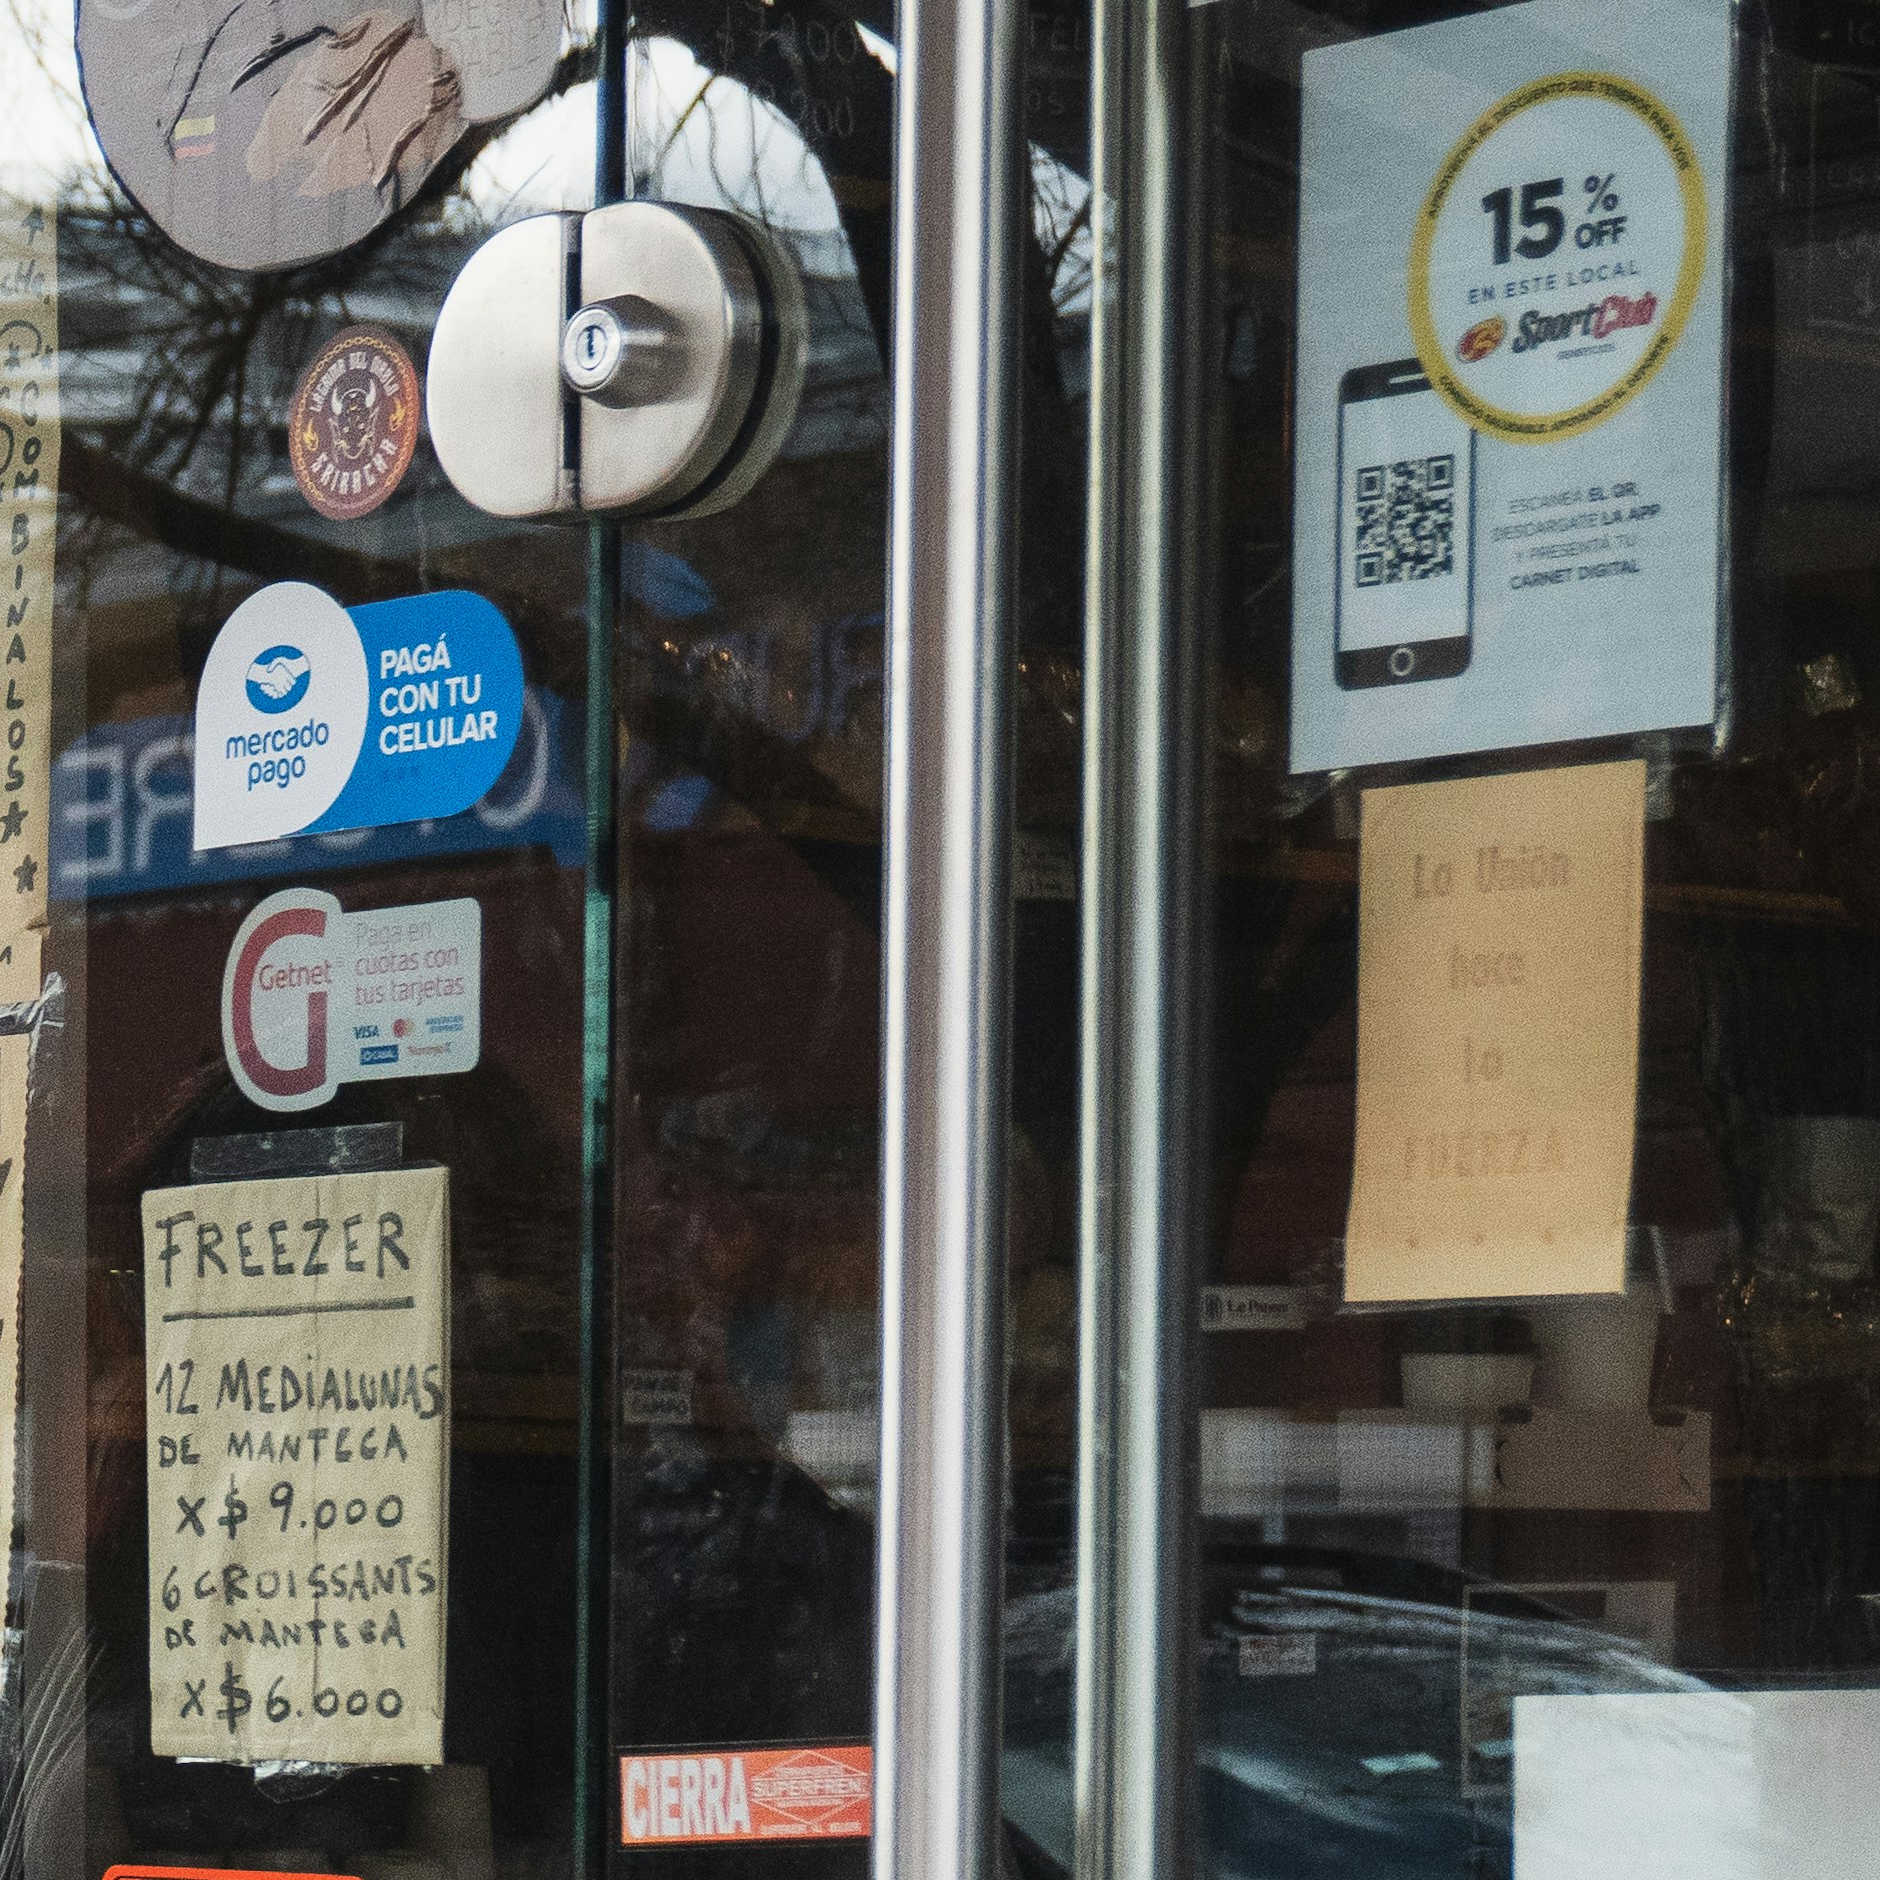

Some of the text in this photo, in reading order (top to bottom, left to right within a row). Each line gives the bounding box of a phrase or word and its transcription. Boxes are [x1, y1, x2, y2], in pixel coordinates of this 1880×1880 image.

[1481, 177, 1565, 266] 15
[1574, 216, 1627, 250] OFF
[1468, 260, 1639, 305] EN ESTE LOCAL
[1627, 503, 1662, 521] APP
[379, 632, 451, 680] PAGÁ
[379, 673, 482, 718] CON TU
[225, 718, 330, 761] mercado
[378, 711, 498, 757] CELULAR
[246, 756, 307, 791] pago
[407, 921, 433, 943] en
[258, 959, 333, 992] Getnet
[354, 947, 459, 977] cuotas con
[354, 976, 466, 1006] tus tarjetas
[352, 1024, 381, 1040] VISA
[154, 1210, 411, 1288] FREEZER
[155, 1354, 443, 1422] 12 MEDIALUNAS
[157, 1423, 409, 1470] DE MANTECA
[161, 1554, 438, 1613] 6 CROISSANTS
[165, 1608, 408, 1651] DE MANTECA
[624, 1756, 753, 1839] CIERRA
